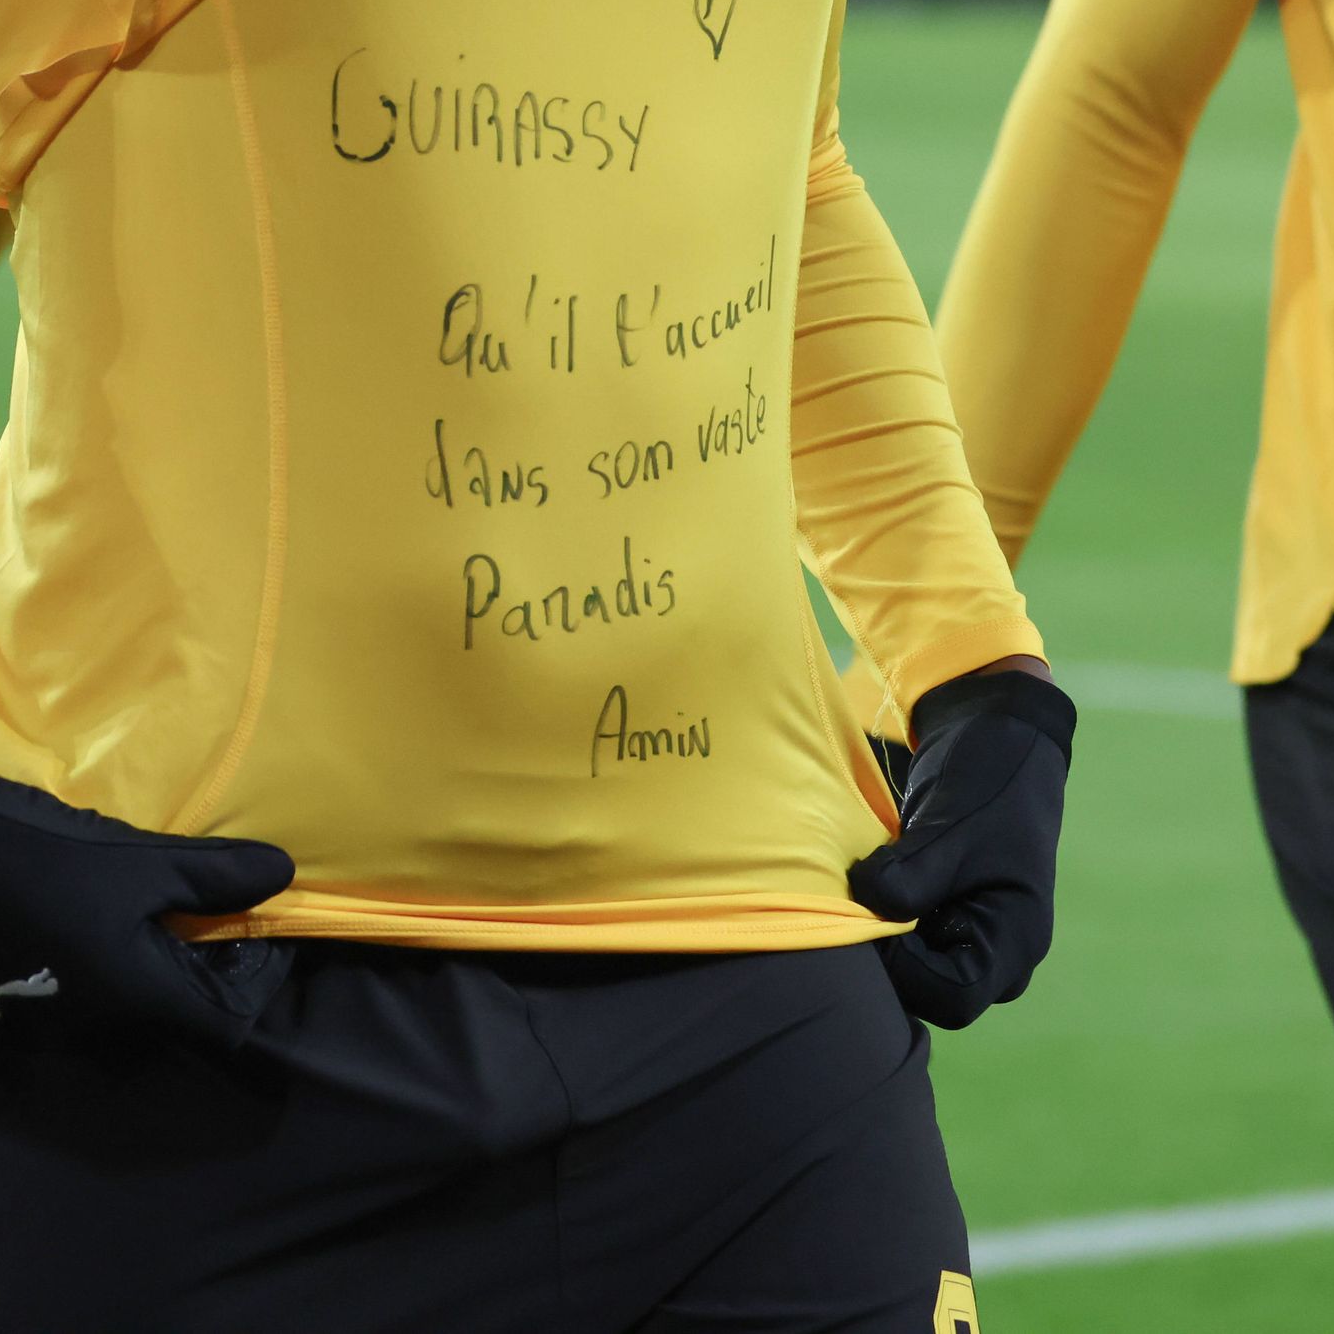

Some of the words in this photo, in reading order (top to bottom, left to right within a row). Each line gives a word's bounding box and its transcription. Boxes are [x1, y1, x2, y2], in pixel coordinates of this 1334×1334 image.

[588, 440, 674, 499] son
[698, 366, 767, 463] vaste
[463, 535, 677, 652] Paradis
